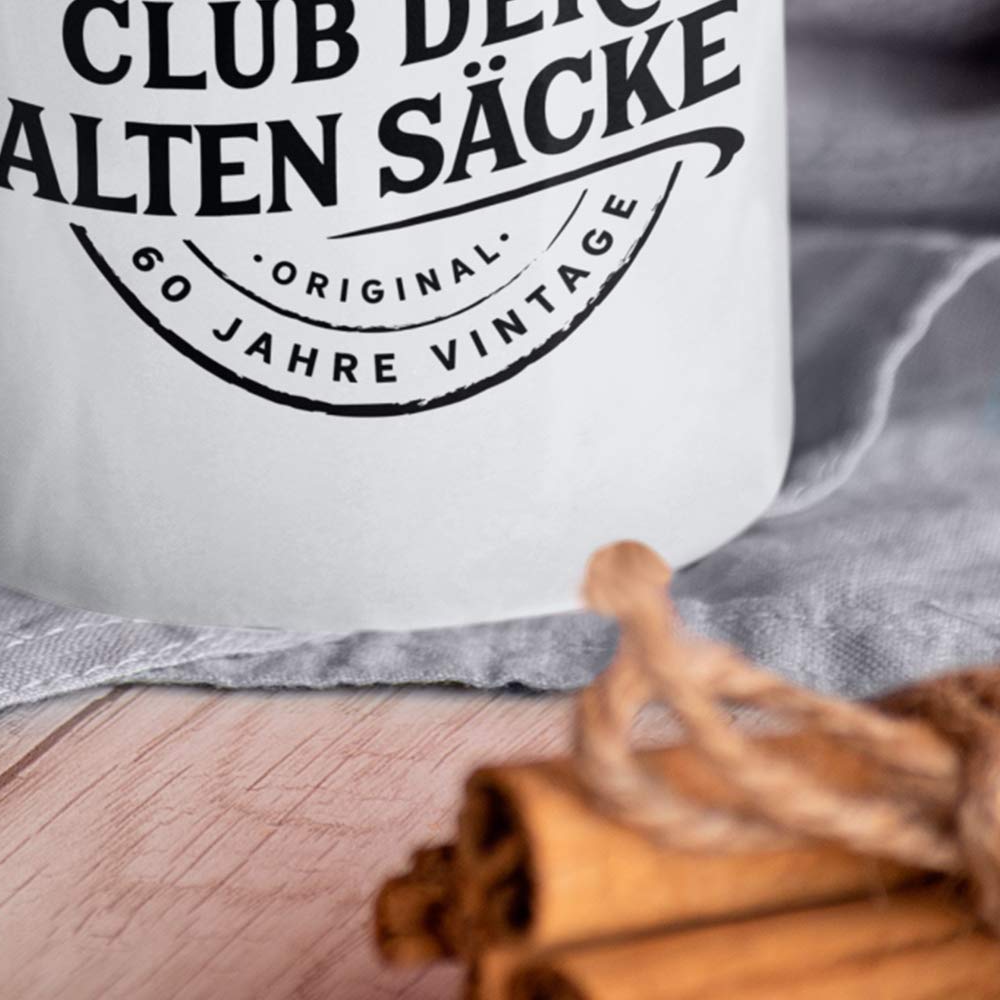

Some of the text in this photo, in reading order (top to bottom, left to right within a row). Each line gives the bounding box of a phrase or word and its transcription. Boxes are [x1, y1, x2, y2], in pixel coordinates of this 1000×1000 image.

[131, 193, 639, 385] 60 JAHRE VINTAGE
[270, 243, 502, 305] ORIGINAL
